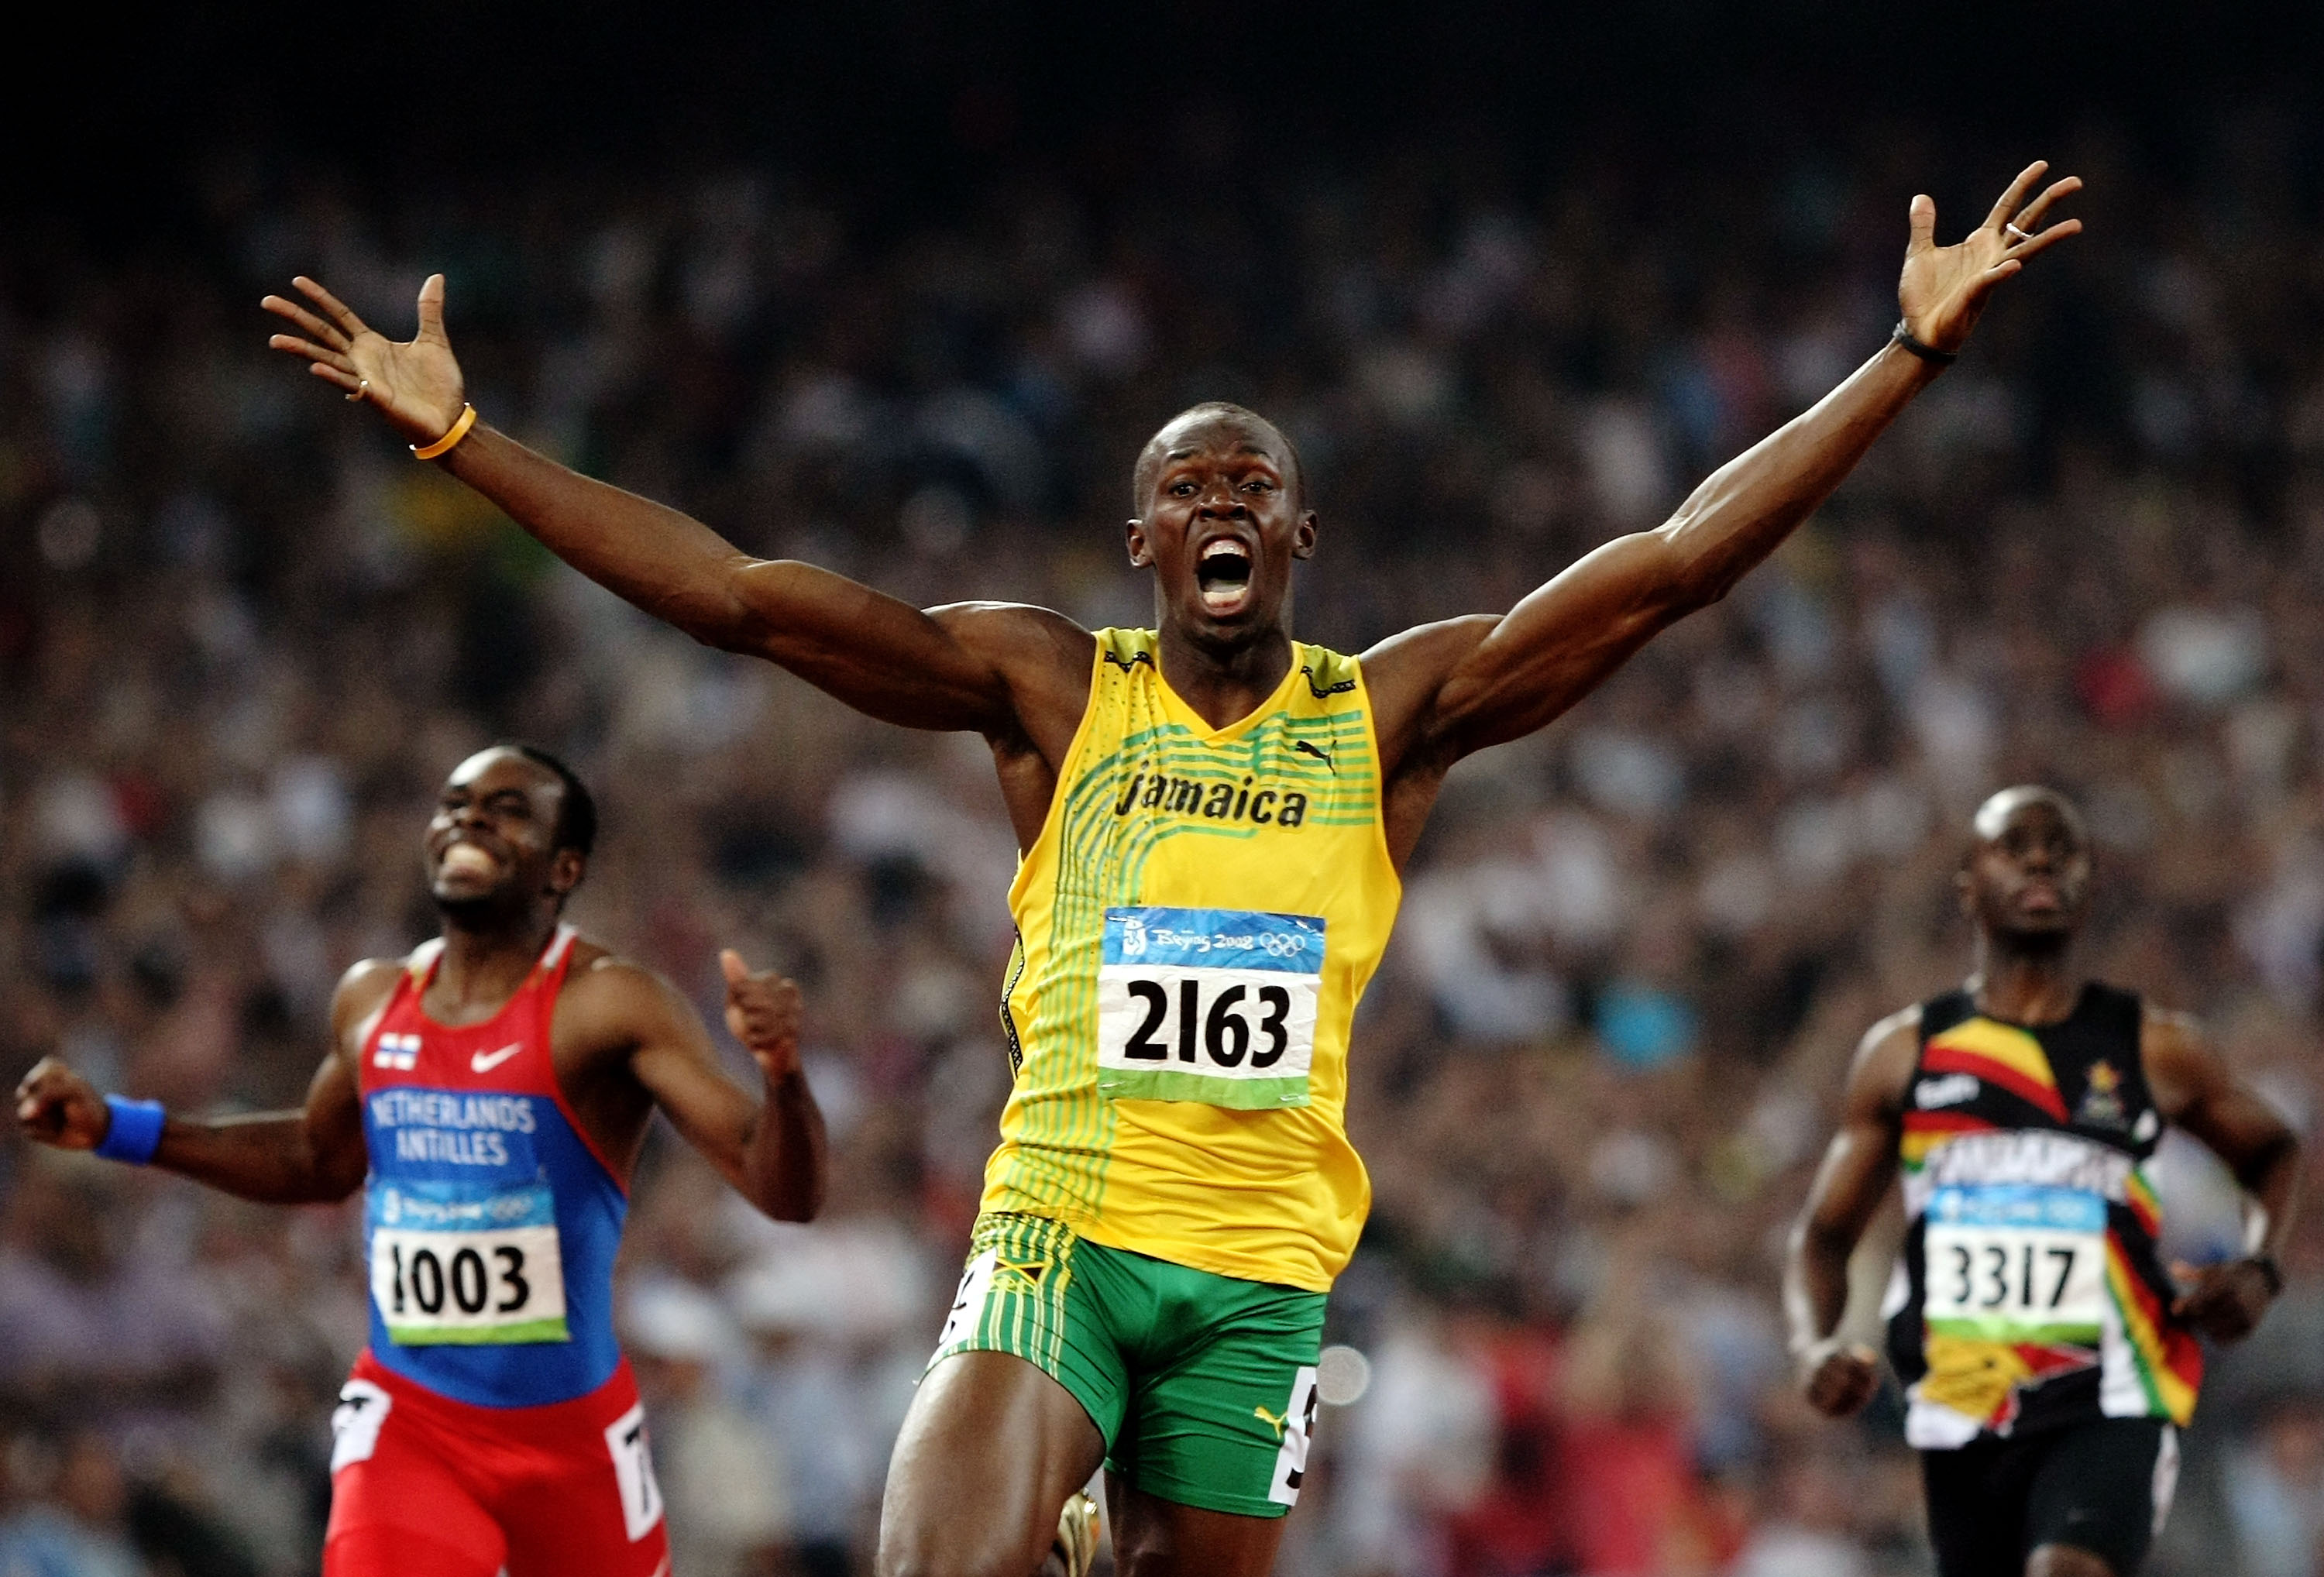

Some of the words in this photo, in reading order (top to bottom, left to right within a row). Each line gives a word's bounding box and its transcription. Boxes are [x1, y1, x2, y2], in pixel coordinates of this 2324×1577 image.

[1116, 760, 1308, 828] jamaica
[1151, 929, 1211, 953] Beijing
[1213, 934, 1254, 950] 2008
[1124, 979, 1291, 1068] 2163
[370, 1089, 537, 1135] NETHERLANDS
[396, 1127, 509, 1166] ANTILLES
[392, 1244, 530, 1314] 1003
[1951, 1244, 2076, 1307] 3317
